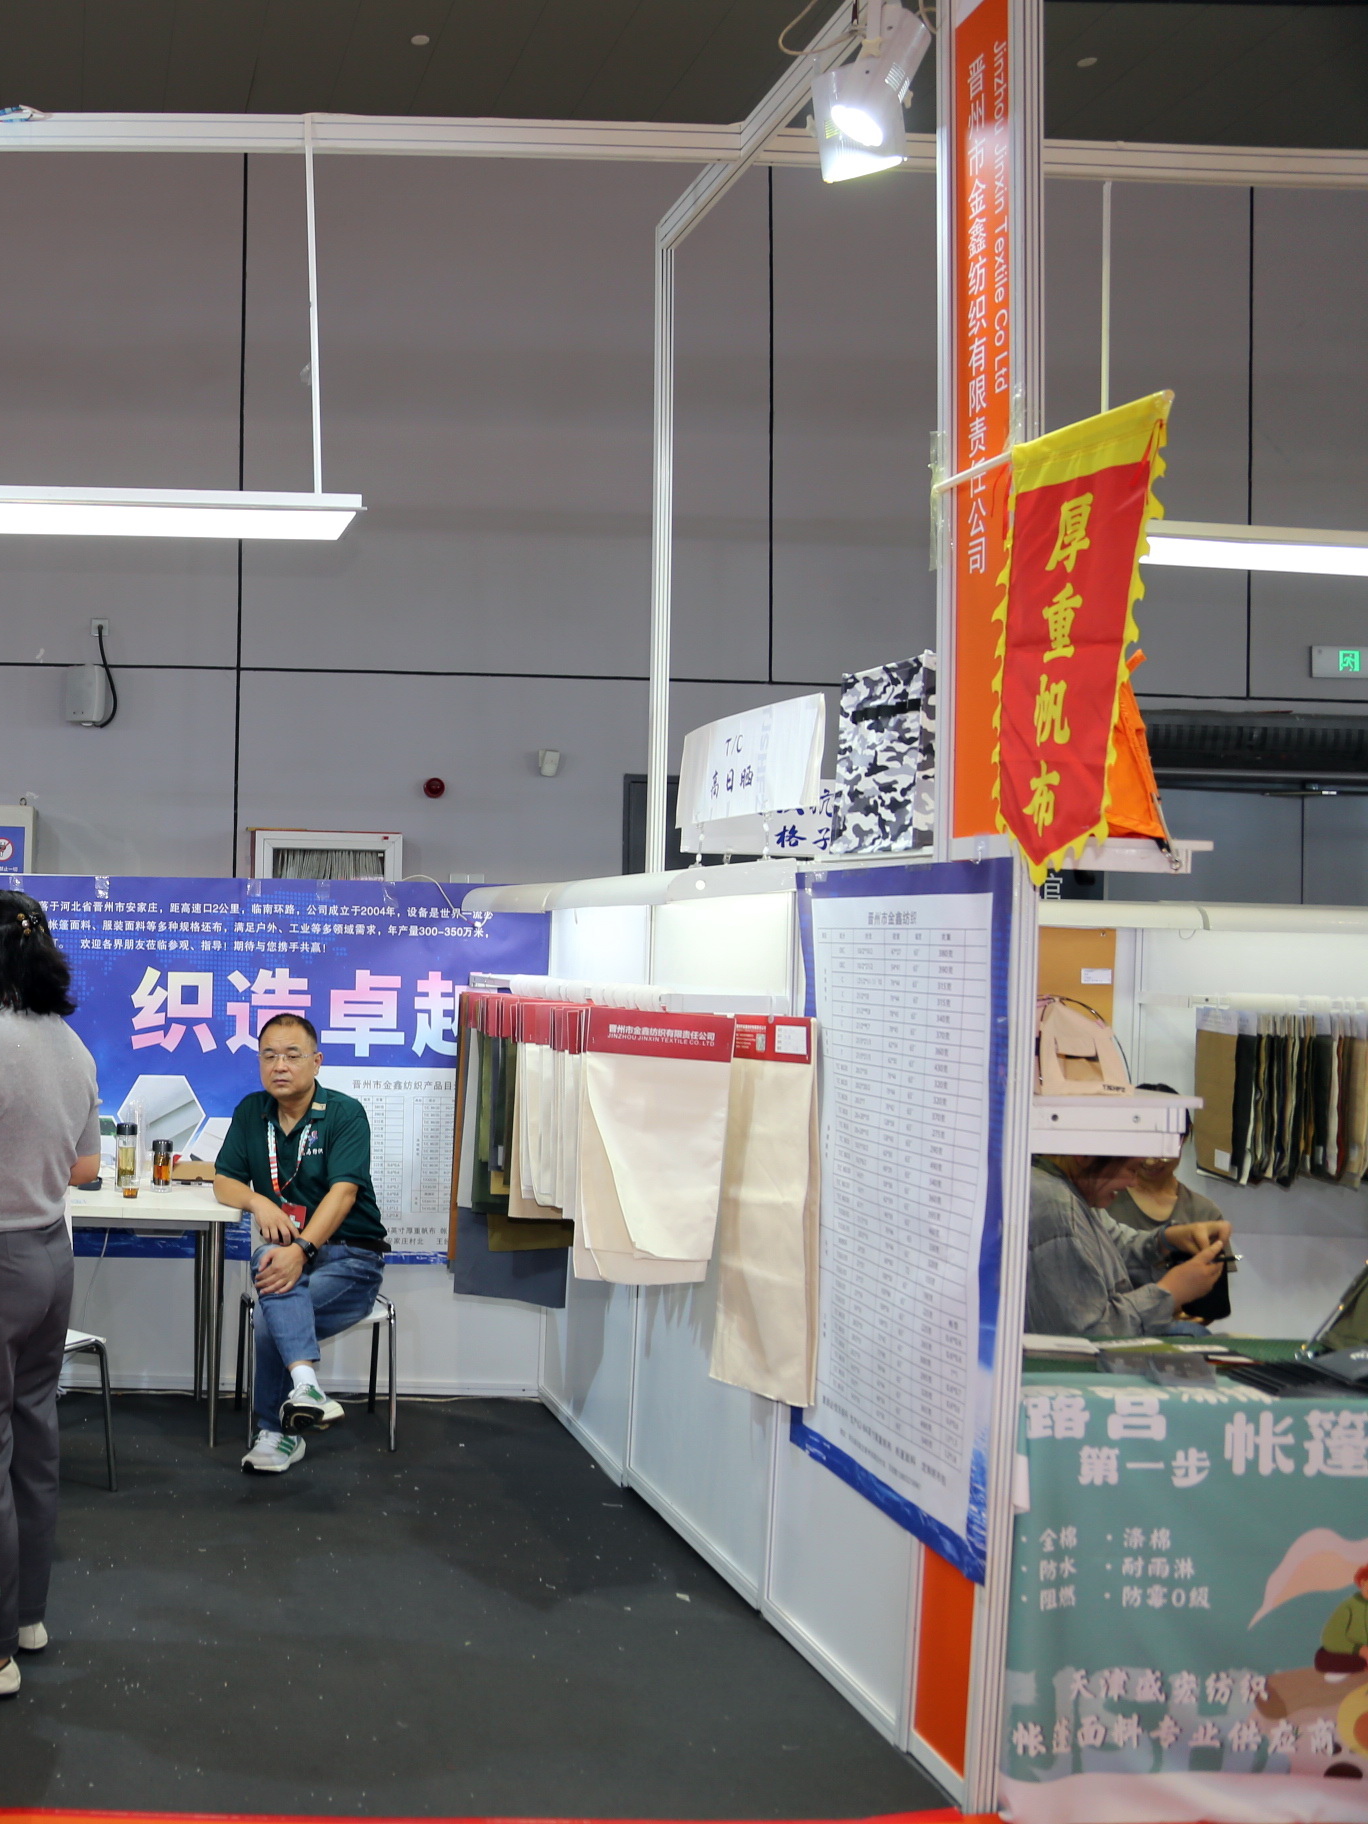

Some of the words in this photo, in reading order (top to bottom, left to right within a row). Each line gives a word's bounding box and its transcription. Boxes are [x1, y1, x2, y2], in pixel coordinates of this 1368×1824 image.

[993, 40, 1007, 136] Jinzhou
[994, 143, 1007, 214] Jinxin
[994, 215, 1008, 304] Textile
[995, 350, 1008, 393] Ltd
[1023, 492, 1094, 838] 厚重帆布
[724, 733, 744, 757] T/C
[352, 1079, 456, 1091] 晋州市金鑫纺织产品目
[1223, 1408, 1368, 1478] 帐篷
[1077, 1444, 1211, 1488] 第一步
[1039, 1525, 1078, 1553] 全棉
[1039, 1555, 1077, 1582] 防水
[1121, 1555, 1195, 1579] 耐雨淋
